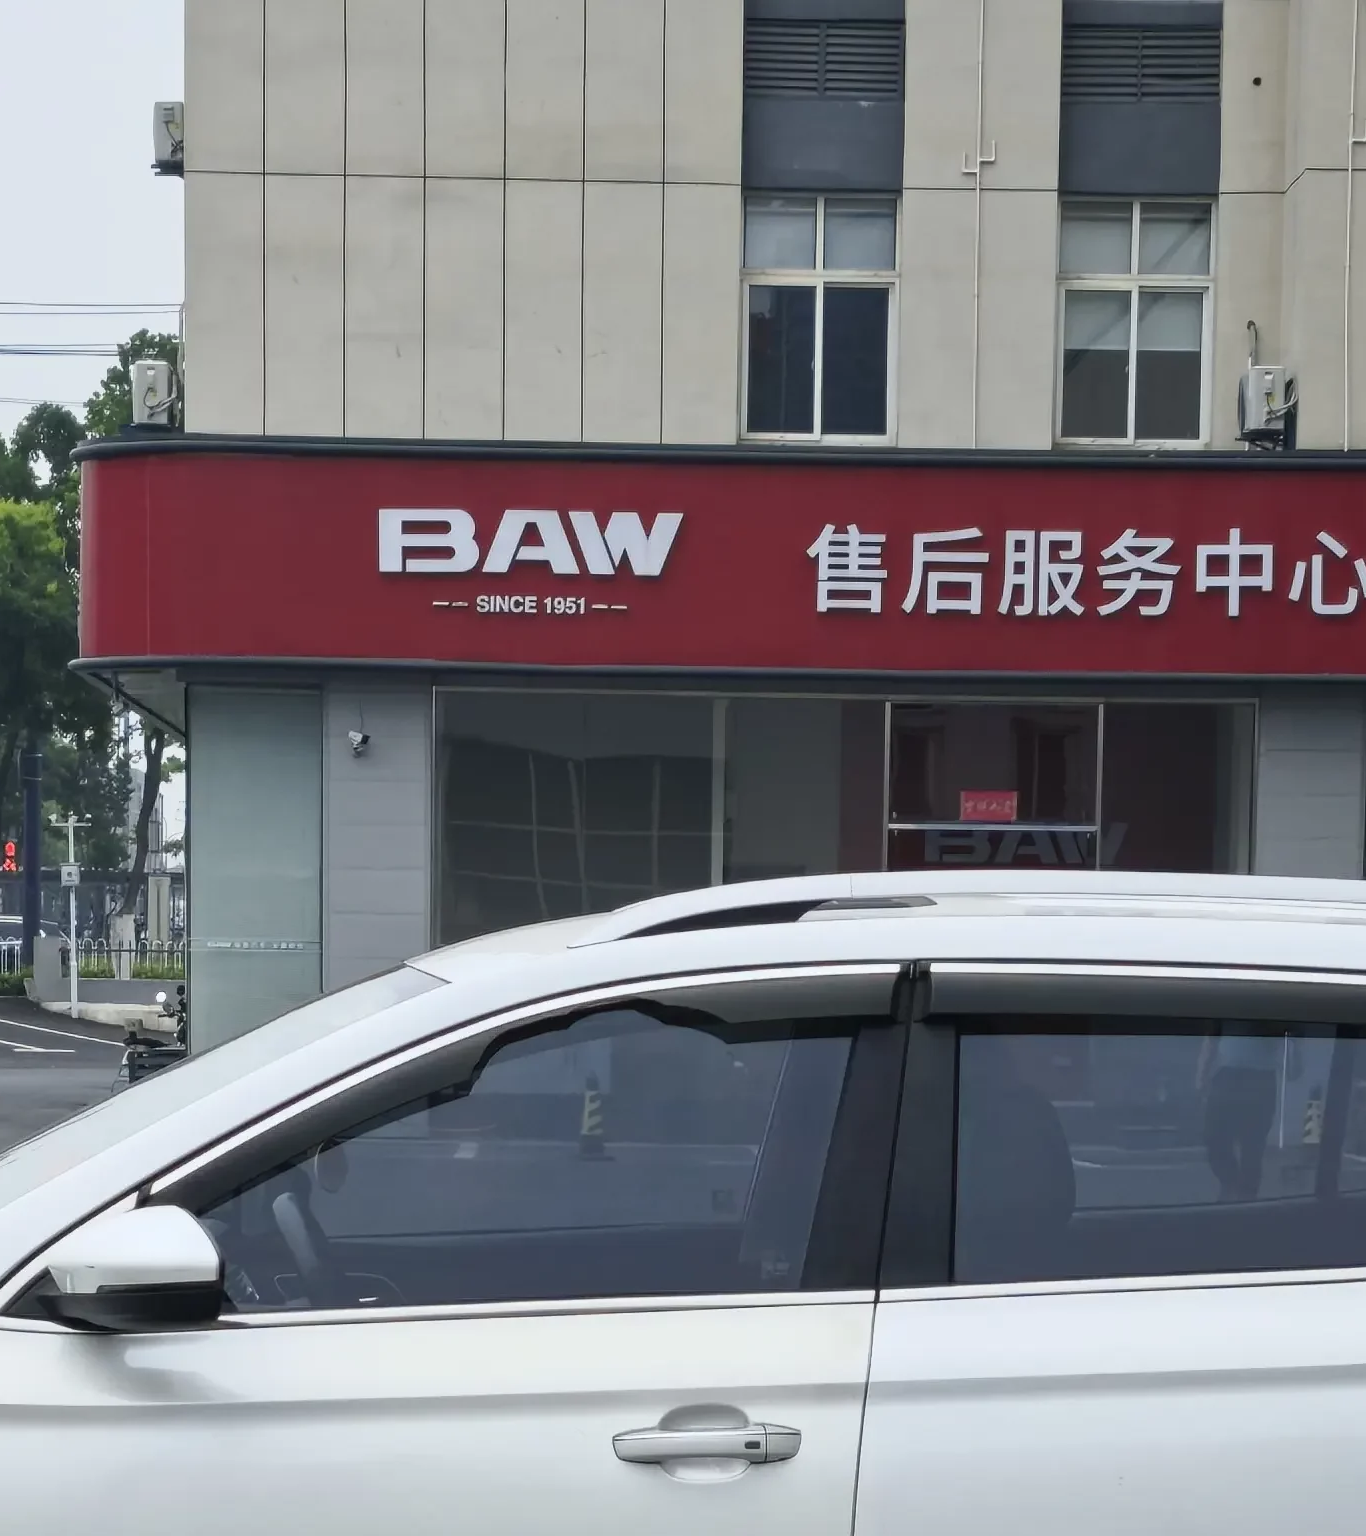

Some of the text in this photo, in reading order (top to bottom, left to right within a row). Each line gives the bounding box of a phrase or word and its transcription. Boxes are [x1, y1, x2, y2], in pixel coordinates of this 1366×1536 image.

[378, 508, 684, 576] BAW
[476, 595, 586, 614] SINCE 1951
